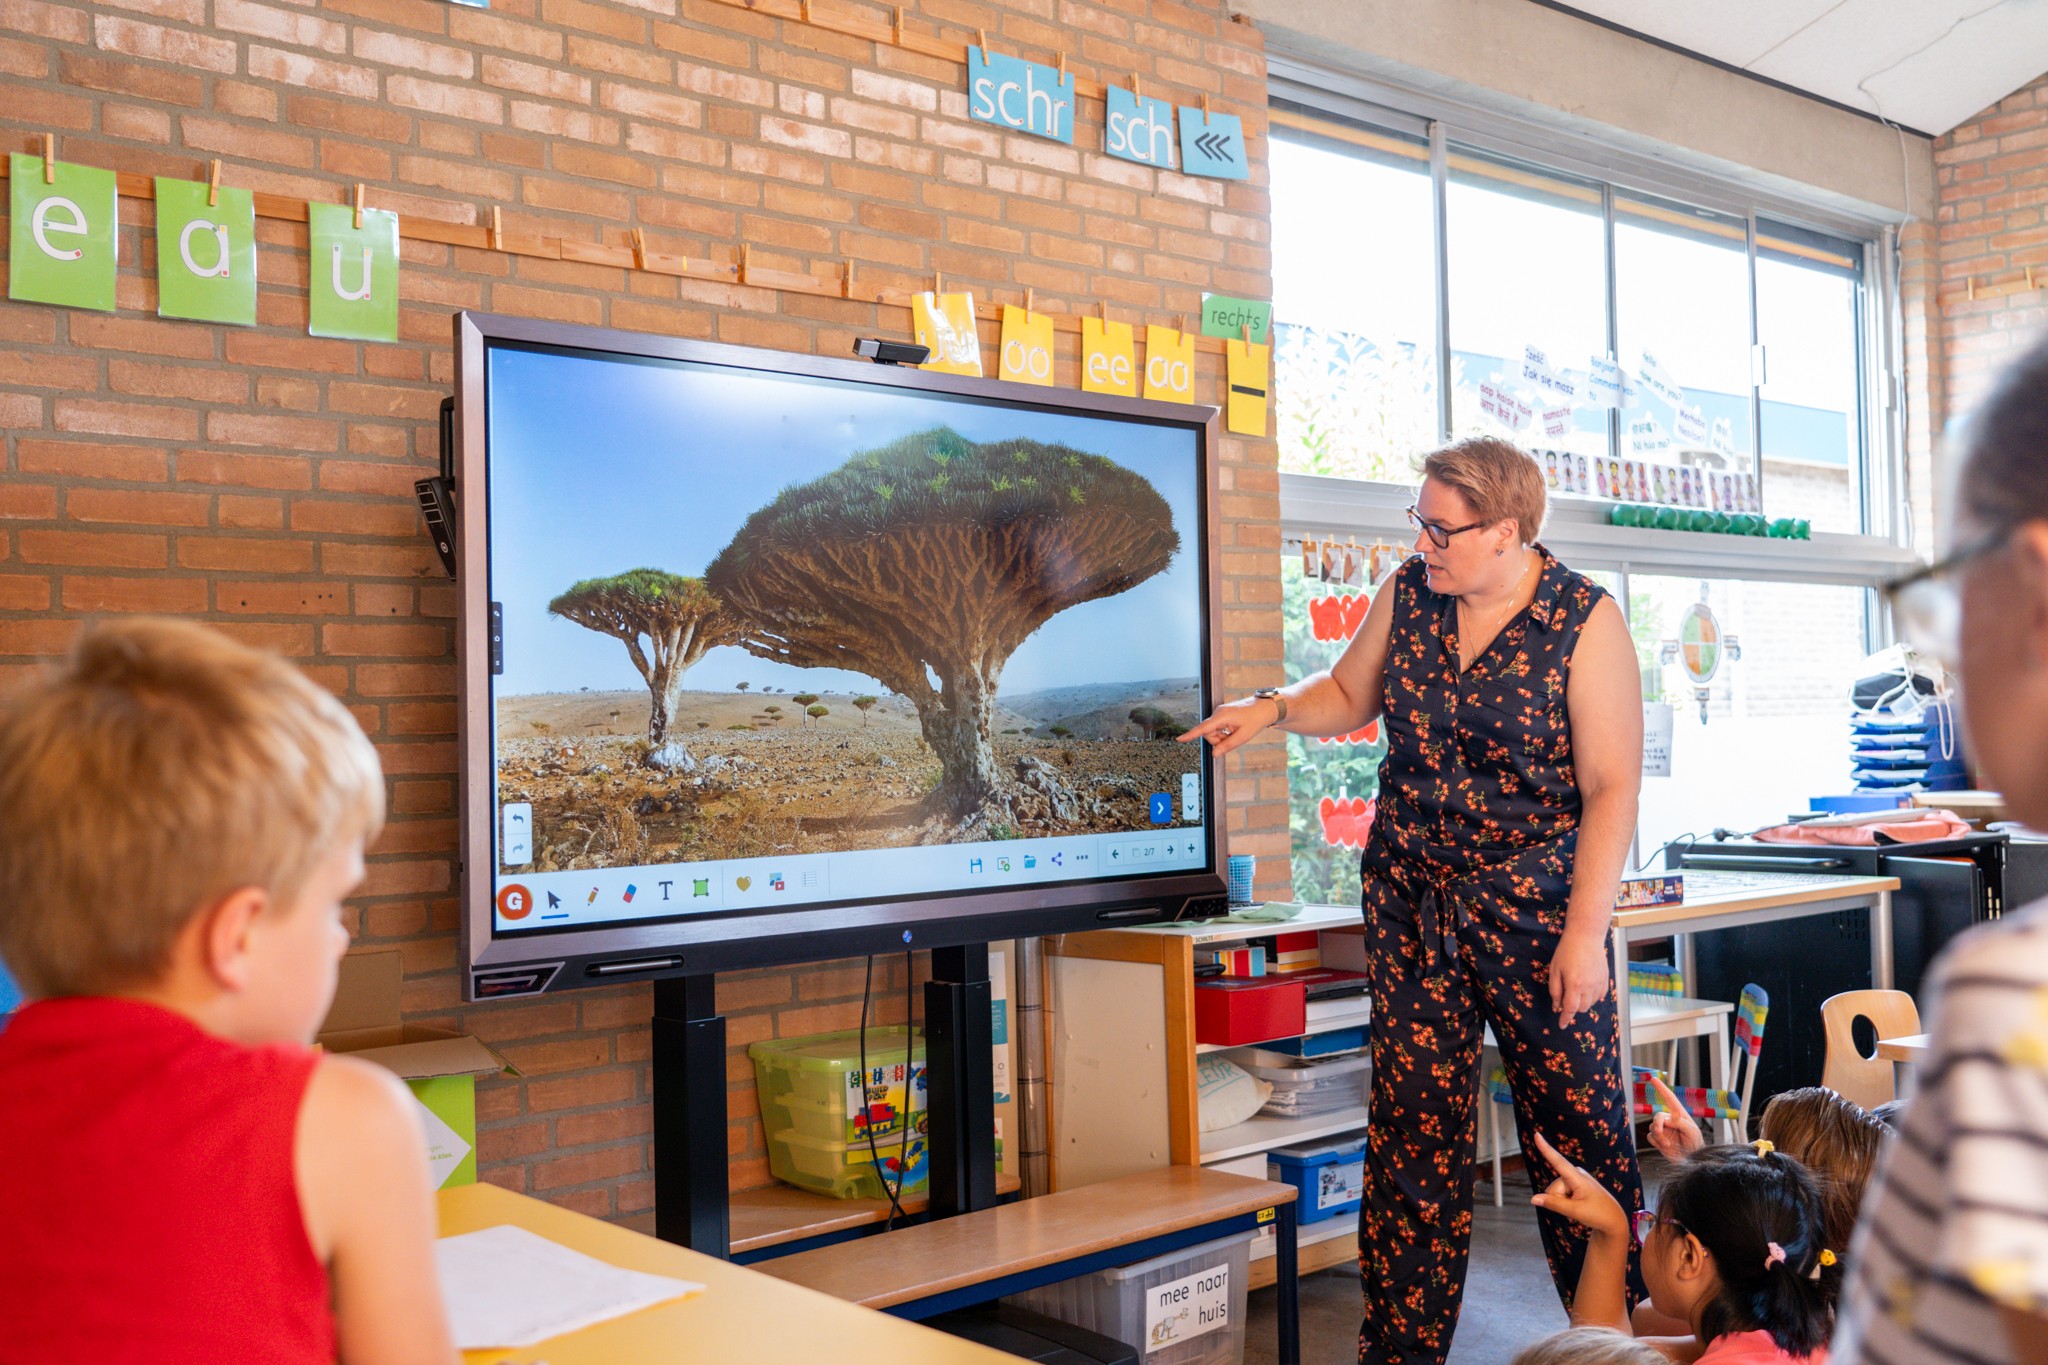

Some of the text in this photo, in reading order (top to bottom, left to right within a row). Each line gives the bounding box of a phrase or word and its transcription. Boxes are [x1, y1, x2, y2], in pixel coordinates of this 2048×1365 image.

[975, 65, 1067, 136] schr
[1109, 101, 1174, 168] sch
[32, 196, 88, 261] e
[179, 218, 230, 278] a
[332, 243, 372, 300] u
[1212, 306, 1260, 330] rechts
[1004, 339, 1050, 378] oo
[1088, 351, 1131, 386] ee
[1148, 356, 1189, 392] aa
[1523, 365, 1538, 381] Jak
[1555, 381, 1575, 395] masz
[1542, 407, 1571, 421] namaste
[1160, 1271, 1227, 1307] mee naar
[1199, 1301, 1226, 1325] huis
